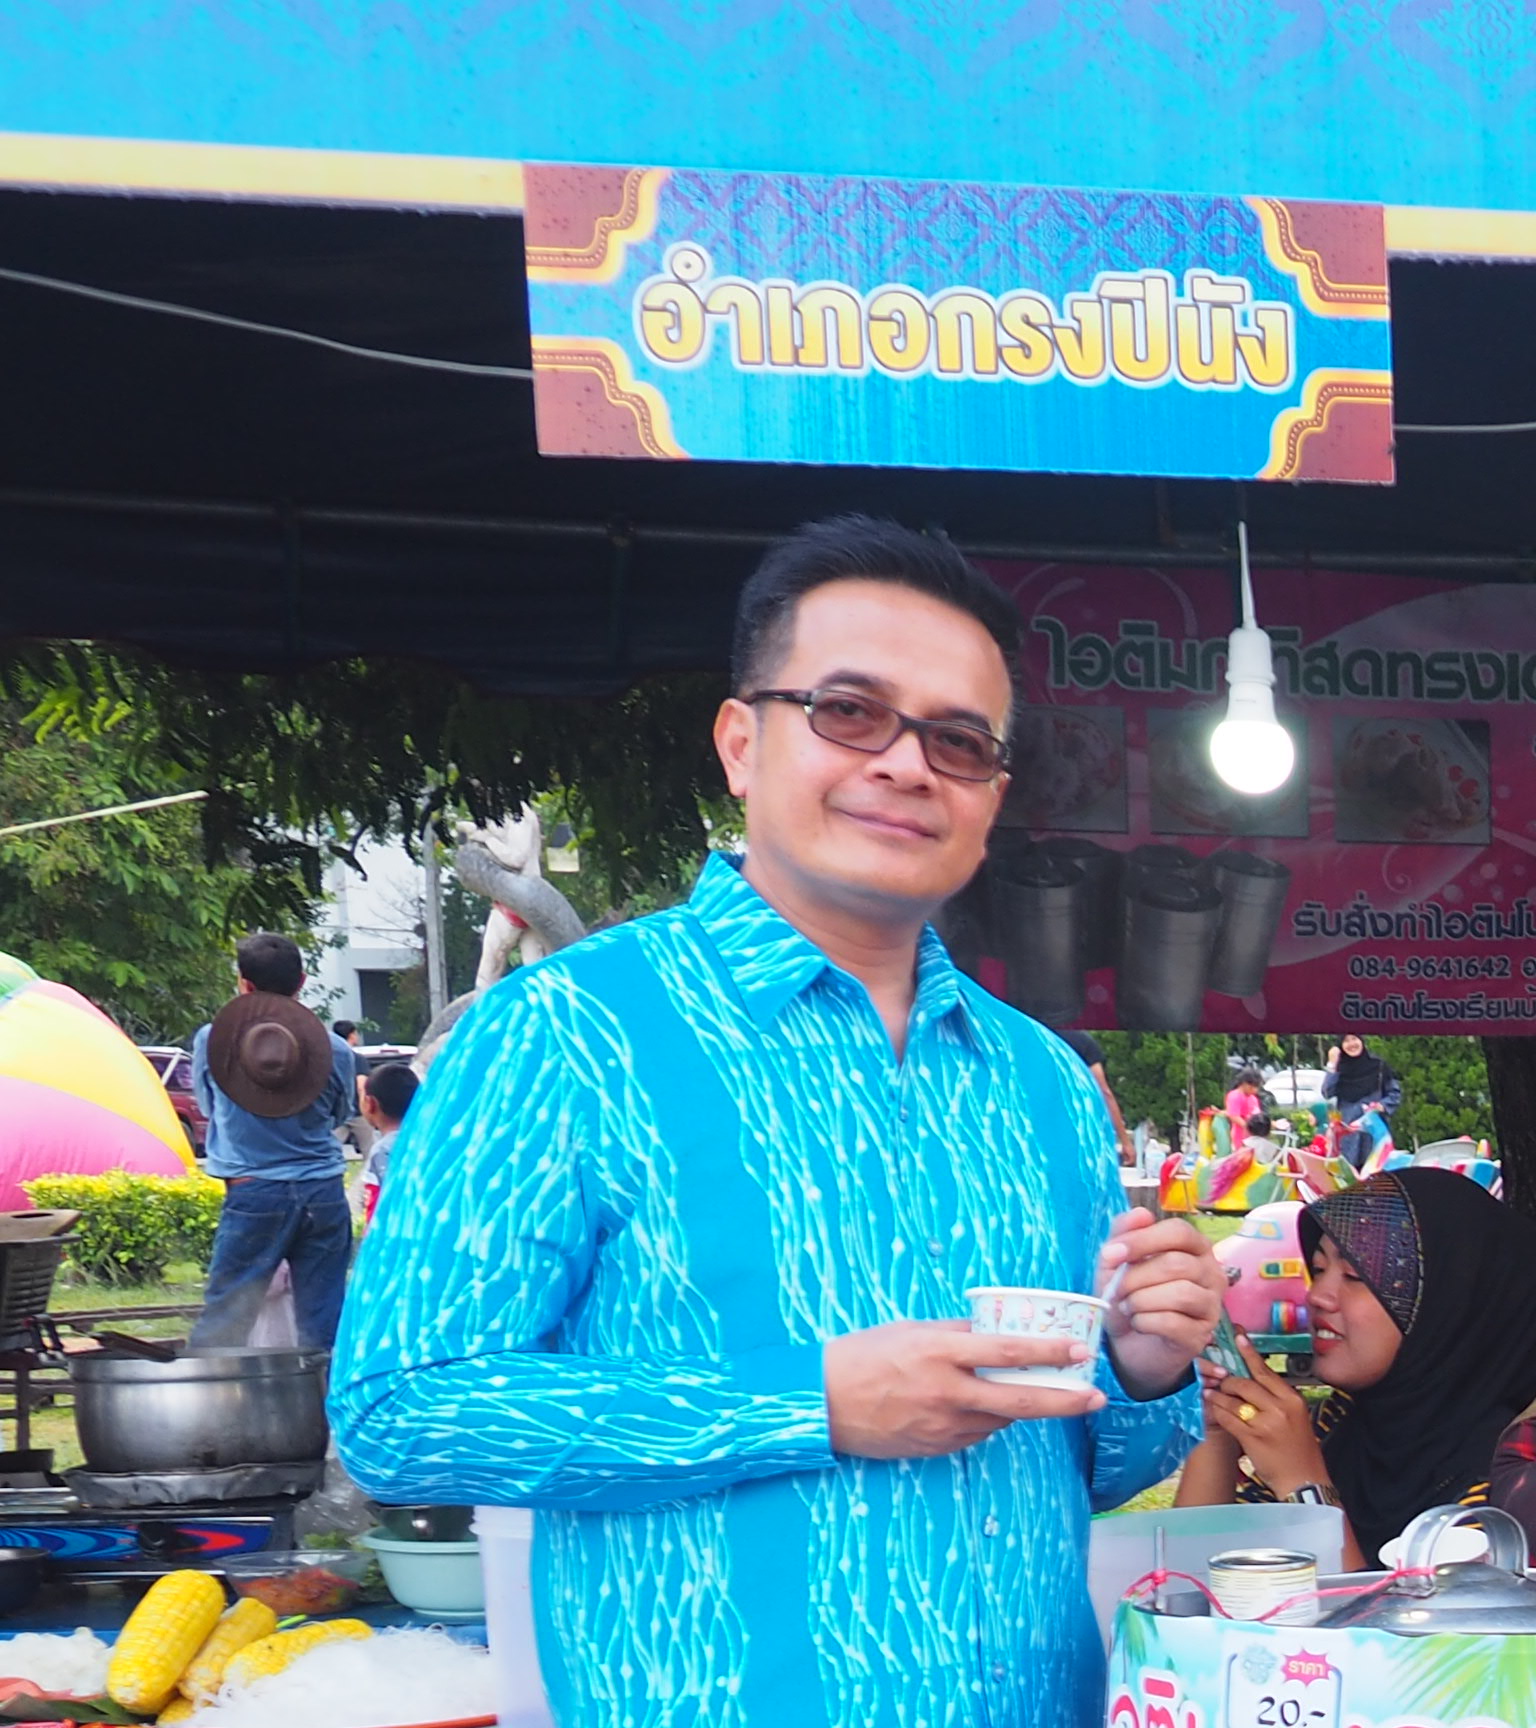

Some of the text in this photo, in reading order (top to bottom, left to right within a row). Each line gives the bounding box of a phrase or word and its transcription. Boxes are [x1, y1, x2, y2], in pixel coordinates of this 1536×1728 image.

[641, 248, 1289, 387] อำเภอกรงปินัง
[1350, 956, 1511, 979] 084-9641642
[1288, 1659, 1326, 1677] ราคา
